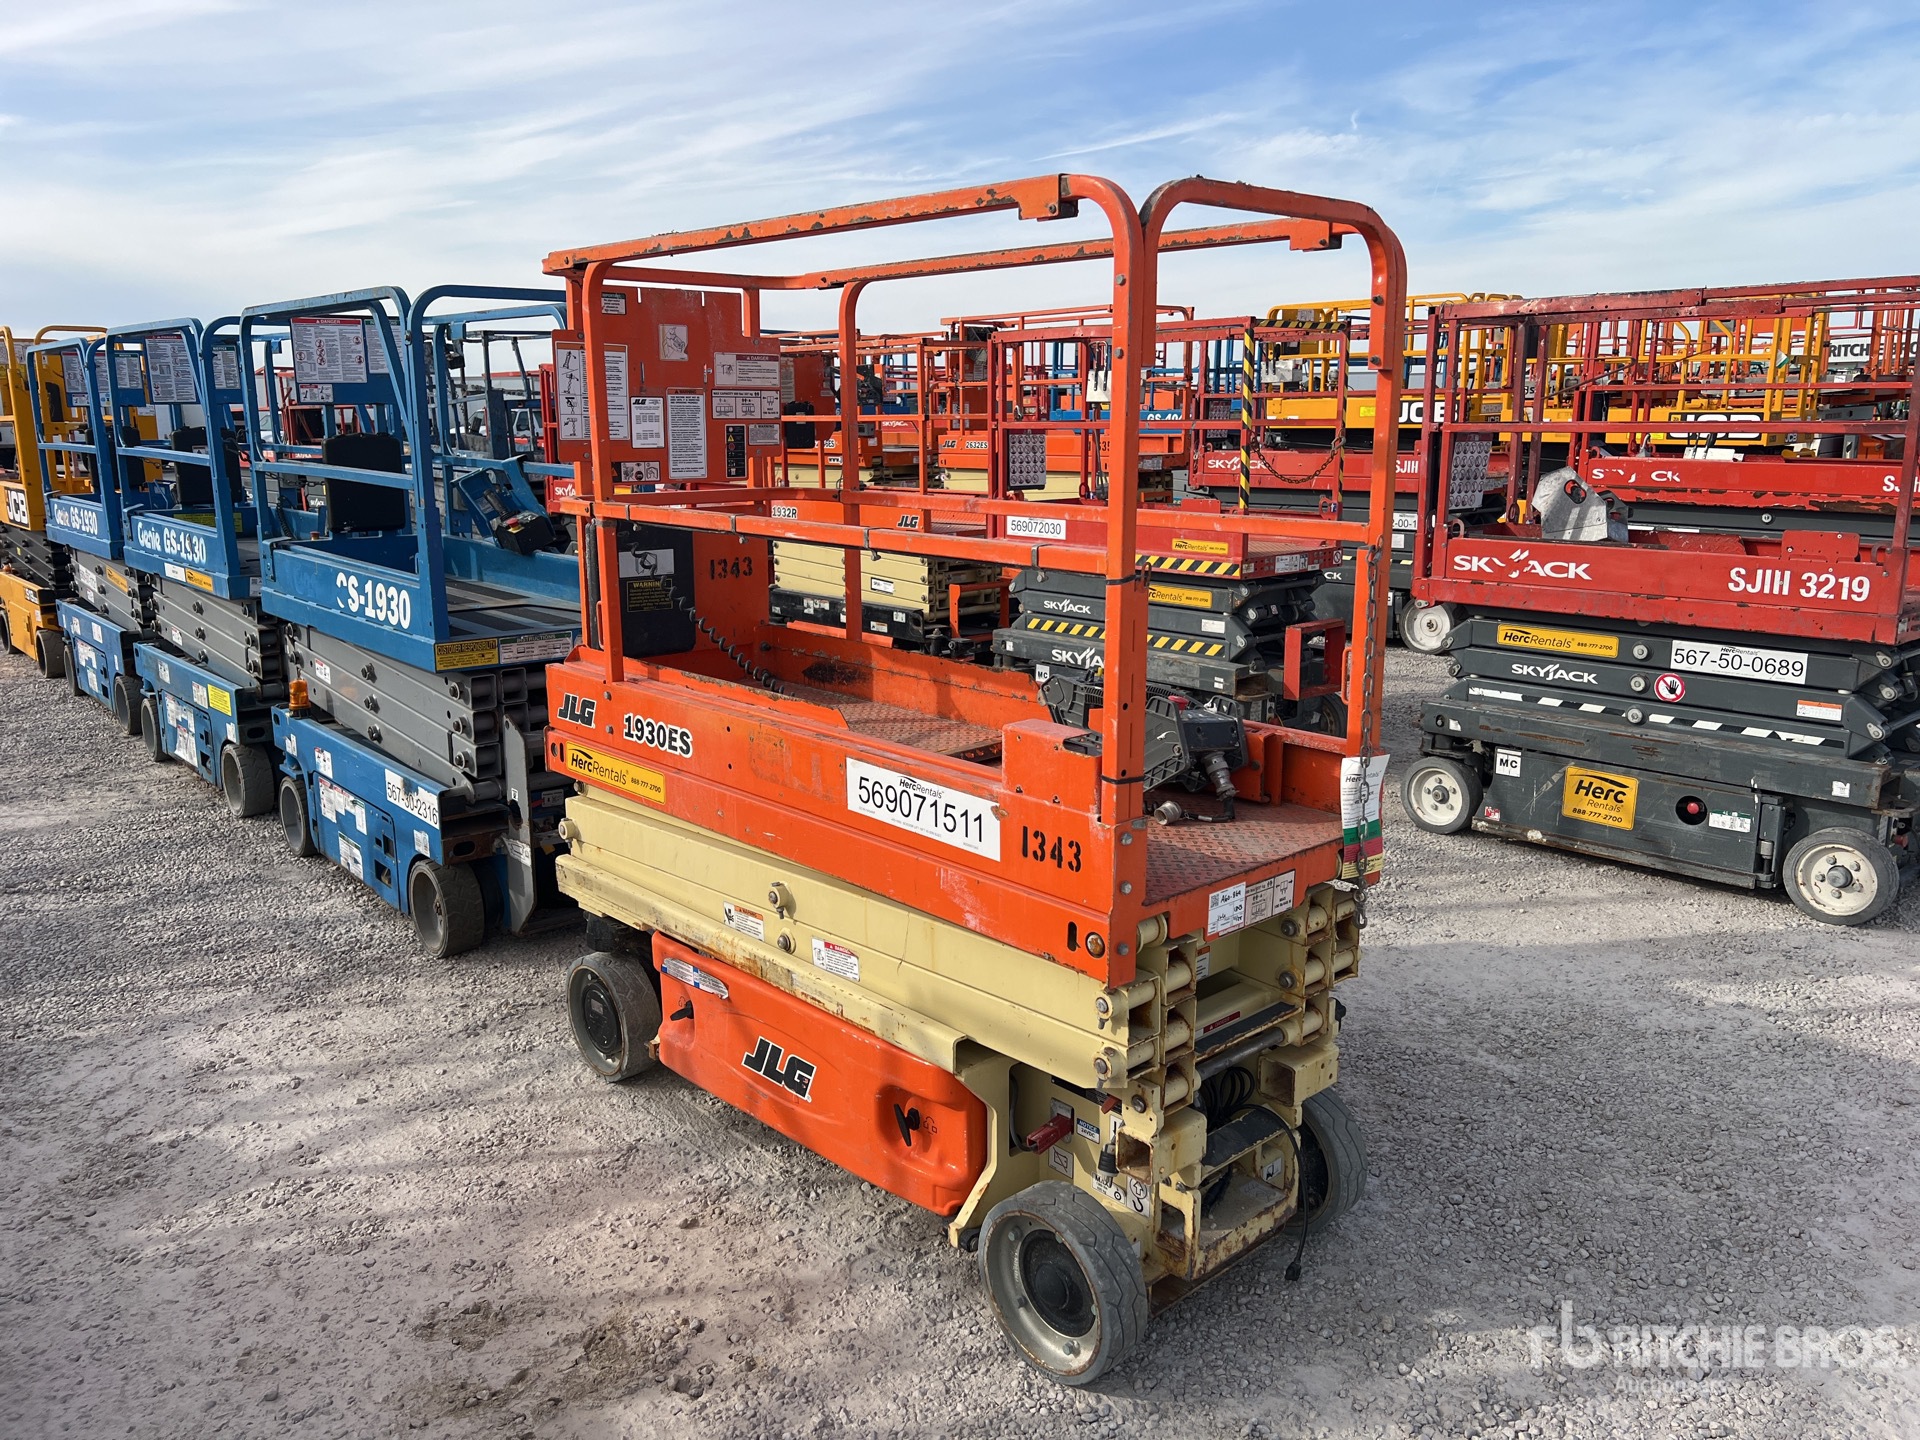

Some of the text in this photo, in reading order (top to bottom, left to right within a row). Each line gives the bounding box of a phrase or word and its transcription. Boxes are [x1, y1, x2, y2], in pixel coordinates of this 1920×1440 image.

[943, 440, 956, 448] JLG
[966, 441, 988, 449] 2632ES
[6, 487, 29, 525] JCB
[771, 506, 797, 519] 1932R
[70, 505, 98, 536] GS-1930
[897, 514, 919, 528] JLG
[1010, 518, 1062, 536] 569072030
[709, 555, 754, 581] 1343
[1799, 571, 1871, 603] 3219
[1043, 598, 1091, 615] SKYJACK
[1503, 631, 1613, 651] HercRentals 888-777-2700
[1673, 647, 1804, 678] 567-50-0689
[1037, 669, 1050, 680] MC
[1510, 663, 1599, 685] SKYJACK
[558, 693, 596, 727] JLG
[624, 714, 692, 757] 1930ES
[570, 750, 662, 794] HercRentals 888-777-2700
[1498, 757, 1518, 770] MC
[899, 778, 943, 800] HercRentals
[1574, 779, 1627, 804] Herc
[386, 780, 439, 825] 567-30-2316
[858, 776, 983, 843] 569071511
[1587, 799, 1622, 813] Rentals
[1572, 807, 1623, 824] 888-777-2700
[1022, 825, 1083, 873] 1343
[741, 1036, 816, 1100] JLG
[1078, 1120, 1098, 1133] NOTICE
